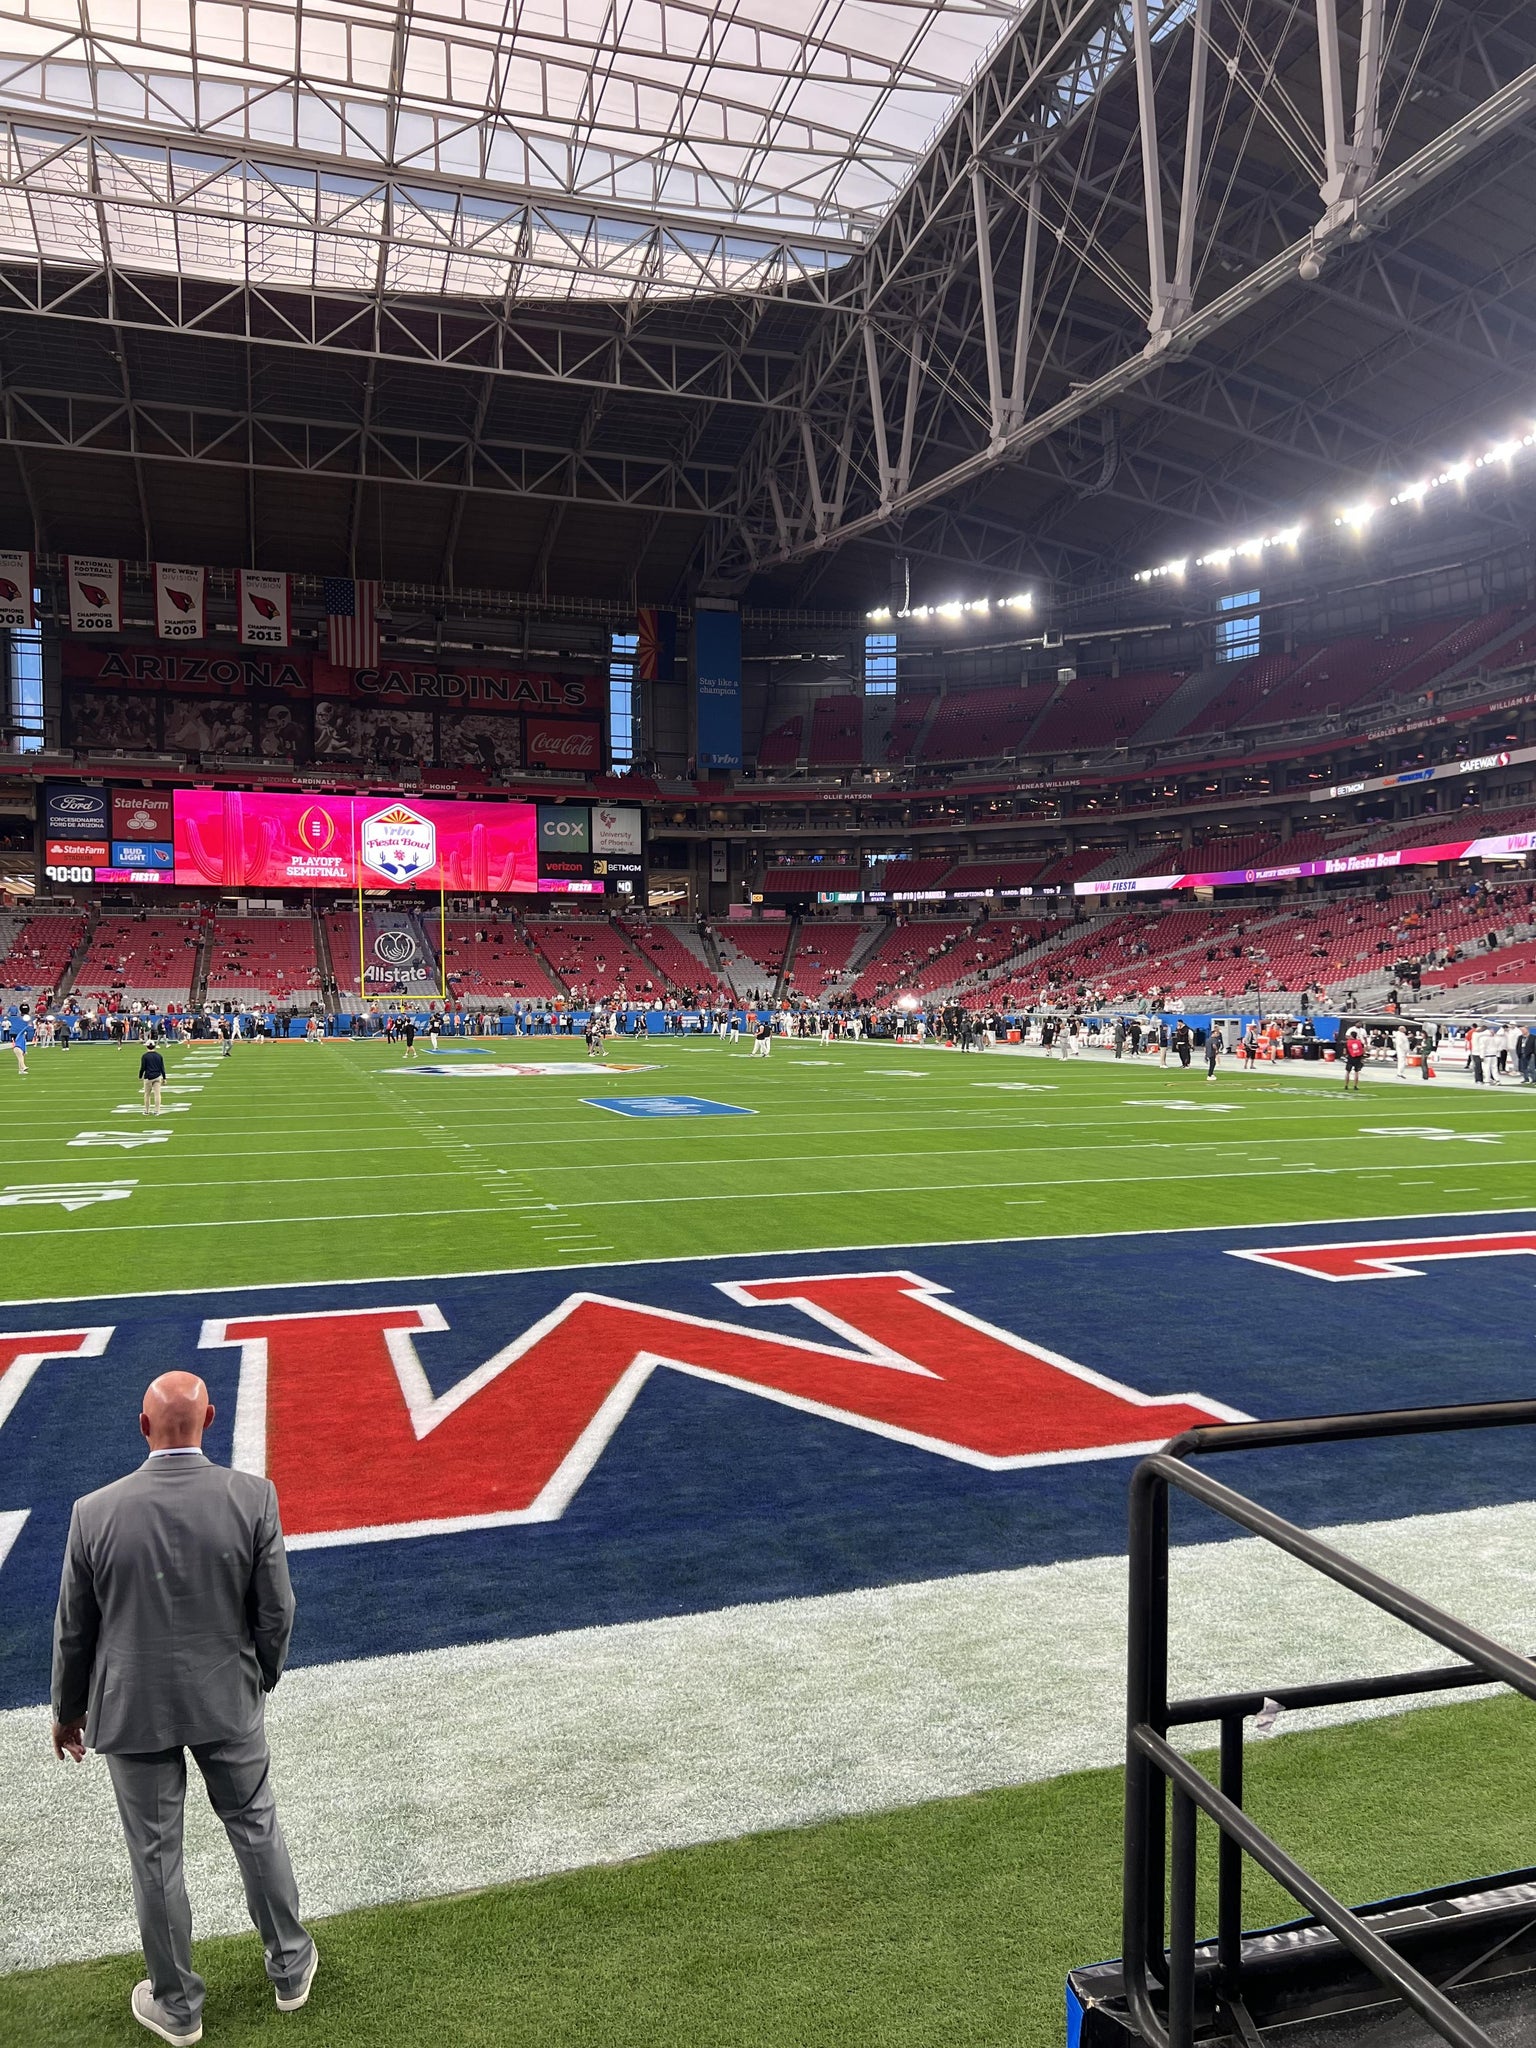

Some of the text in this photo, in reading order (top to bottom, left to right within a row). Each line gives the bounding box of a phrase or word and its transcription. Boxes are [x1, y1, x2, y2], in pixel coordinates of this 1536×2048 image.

[74, 560, 113, 569] NATIONAL
[74, 566, 113, 574] FOOTBALL
[162, 574, 199, 582] DIVISION
[246, 581, 281, 590] DIVISION
[77, 619, 113, 629] 2008
[164, 625, 198, 636] 2009
[247, 630, 282, 642] 2015
[100, 652, 588, 707] ARIZONA CARDINALS
[699, 677, 717, 687] Stay
[718, 678, 733, 687] like
[1489, 697, 1523, 712] WILLIAM
[1367, 728, 1396, 741] CHARLES
[1436, 716, 1448, 725] SR.
[711, 754, 739, 765] Vrbo
[1459, 755, 1498, 773] SAFEWAY
[429, 783, 456, 791] HONOR
[1045, 779, 1081, 788] WILLIAMS
[60, 796, 94, 810] Ford
[383, 825, 415, 836] Vrbo
[543, 821, 584, 837] COX
[600, 831, 632, 840] University
[366, 836, 431, 850] Fiesta Bowl
[123, 847, 143, 855] BUD
[119, 853, 146, 861] LIGHT
[291, 856, 343, 867] PLAYOFF
[1347, 857, 1376, 871] Fiesta
[1376, 851, 1401, 867] Bowl
[286, 865, 348, 878] SEMIFINAL
[545, 861, 583, 871] verizon
[45, 865, 93, 882] 90:00
[130, 872, 160, 882] FIESTA
[568, 882, 593, 892] FIESTA
[617, 881, 632, 892] 40
[1094, 880, 1137, 892] VIVA FIESTA
[363, 964, 428, 984] Allstate
